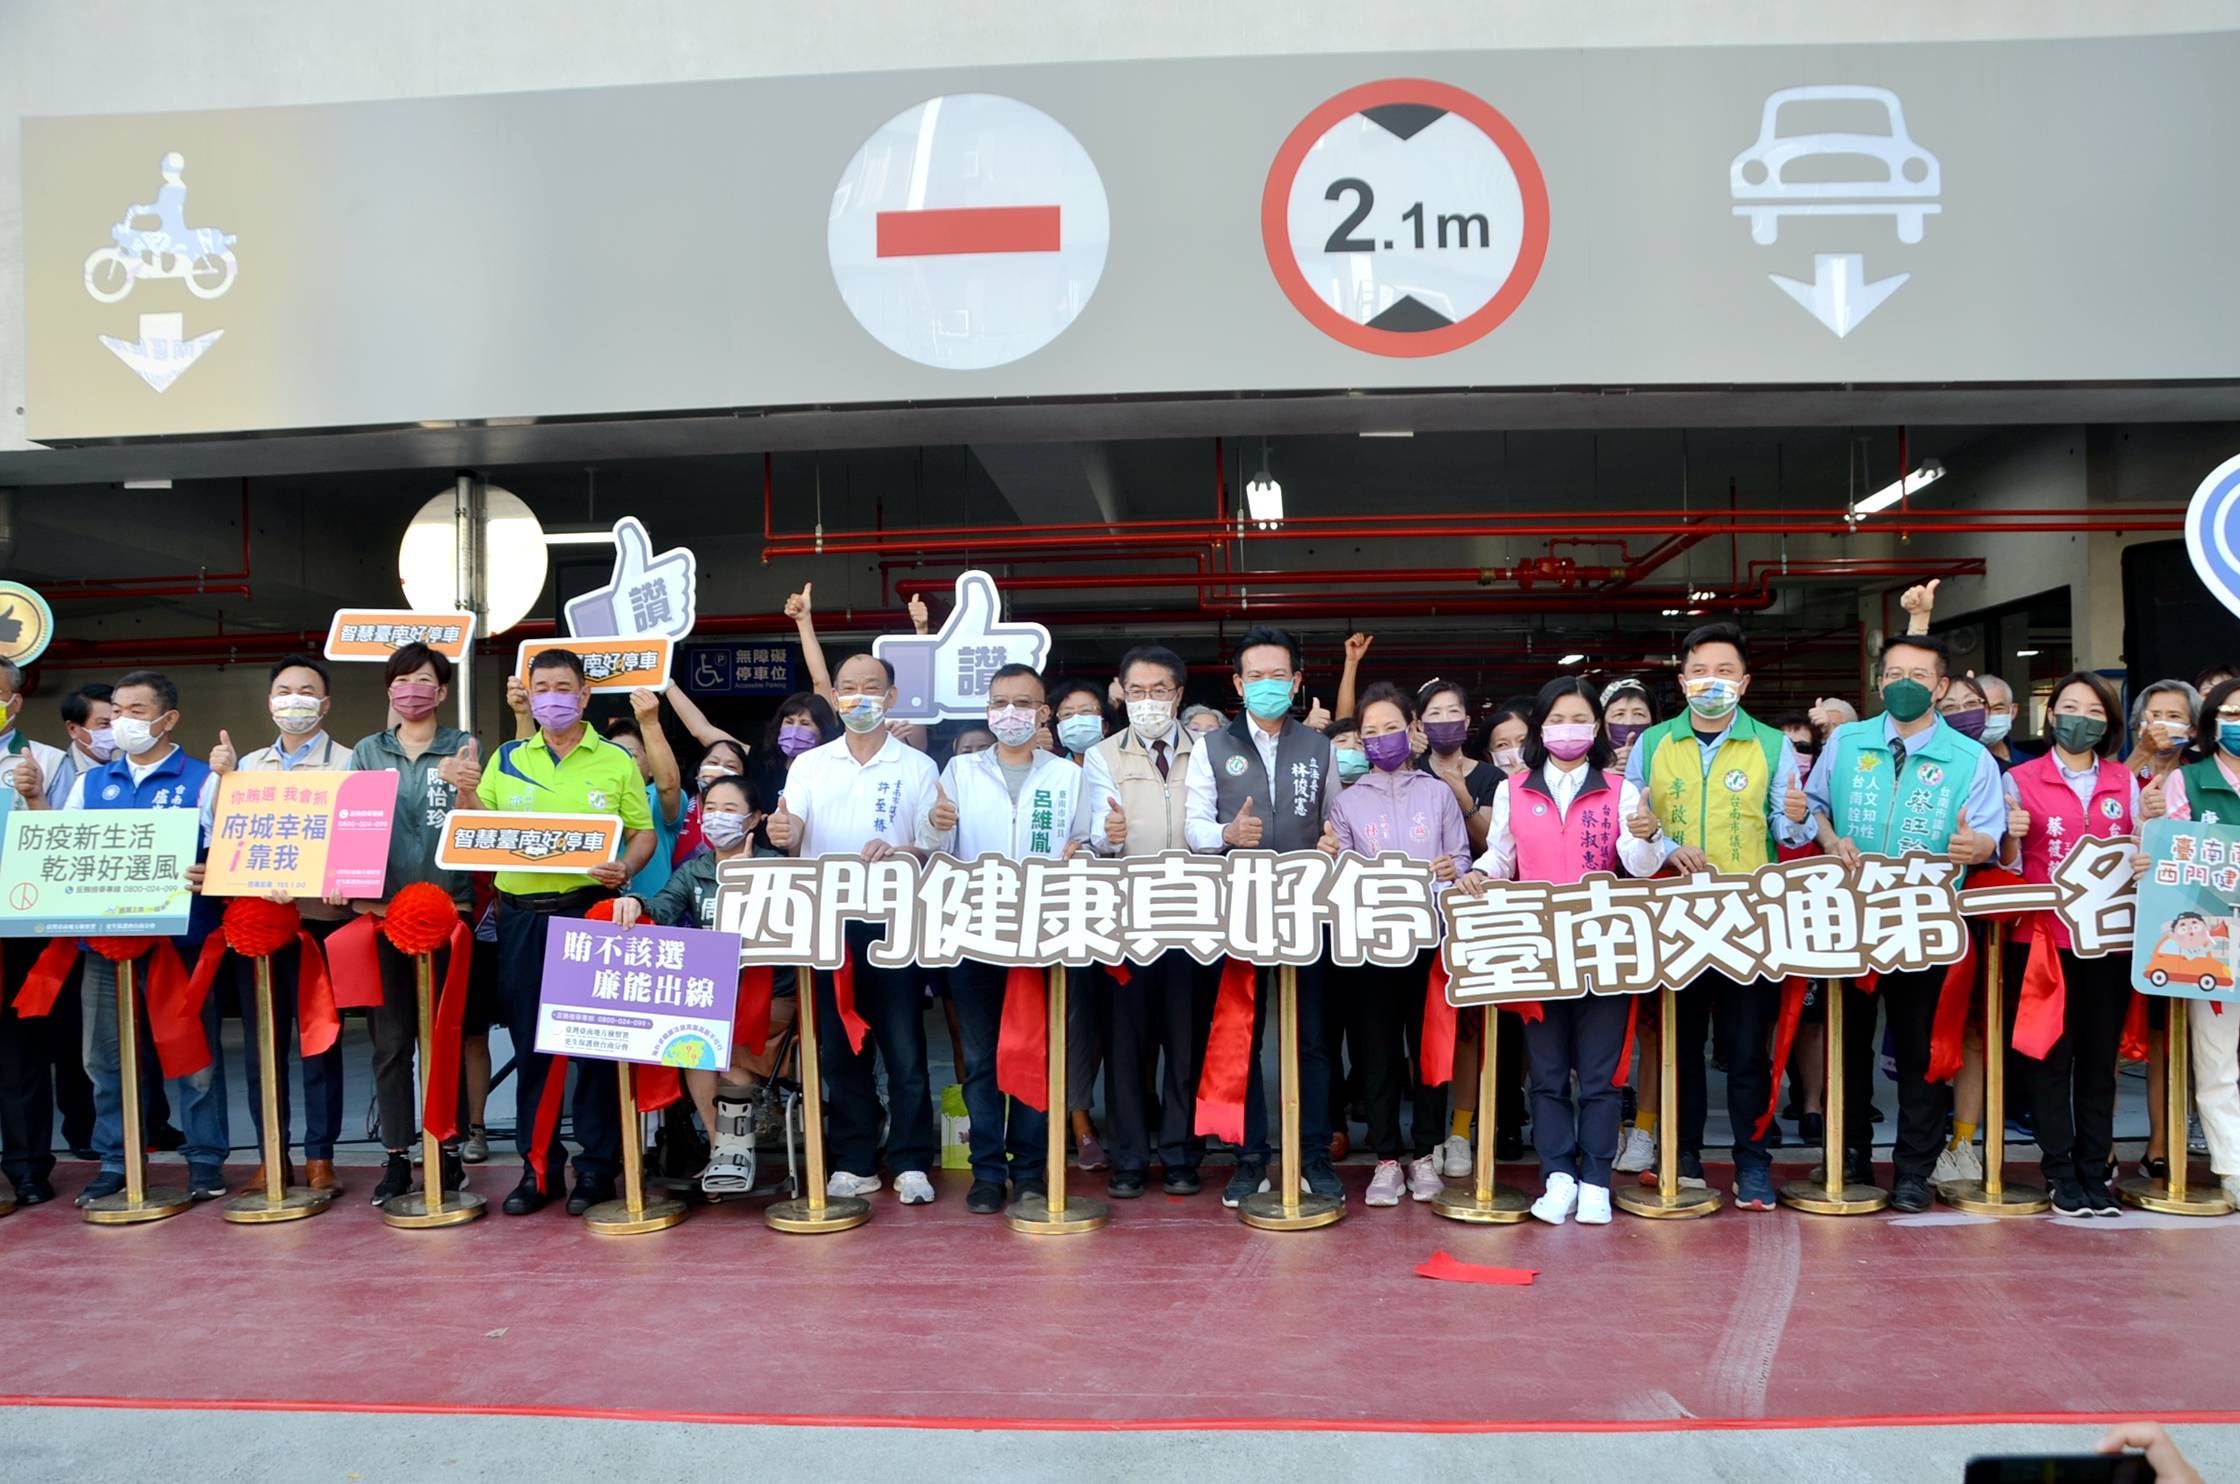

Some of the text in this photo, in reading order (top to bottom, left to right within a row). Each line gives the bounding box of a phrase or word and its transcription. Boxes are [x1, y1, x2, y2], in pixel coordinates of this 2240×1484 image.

[1324, 177, 1490, 253] 2.1m
[628, 577, 672, 633] 讚
[340, 624, 461, 643] 智慧臺南好停車
[735, 648, 787, 663] 無障礙
[958, 646, 1007, 696] 讚
[735, 666, 787, 681] 停車位
[167, 784, 187, 809] 台南
[231, 786, 329, 806] 你賄選 我會抓
[1291, 763, 1311, 817] 林俊憲
[1861, 775, 1880, 840] 人文知性
[17, 823, 156, 851] 防疫新生活
[221, 813, 329, 841] 府城幸福
[1030, 789, 1053, 853] 呂維胤
[454, 828, 605, 851] 智慧臺南好停車
[1580, 809, 1600, 871] 蔡淑惠
[40, 854, 179, 882] 乾淨好選風
[245, 843, 300, 872] 靠我
[123, 884, 178, 893] 0800-024-099
[720, 857, 1434, 962] 西門健康真好停
[1447, 843, 2137, 997] 臺南交通第一名
[562, 930, 686, 971] 賄不該選
[591, 968, 716, 1009] 廉能出線
